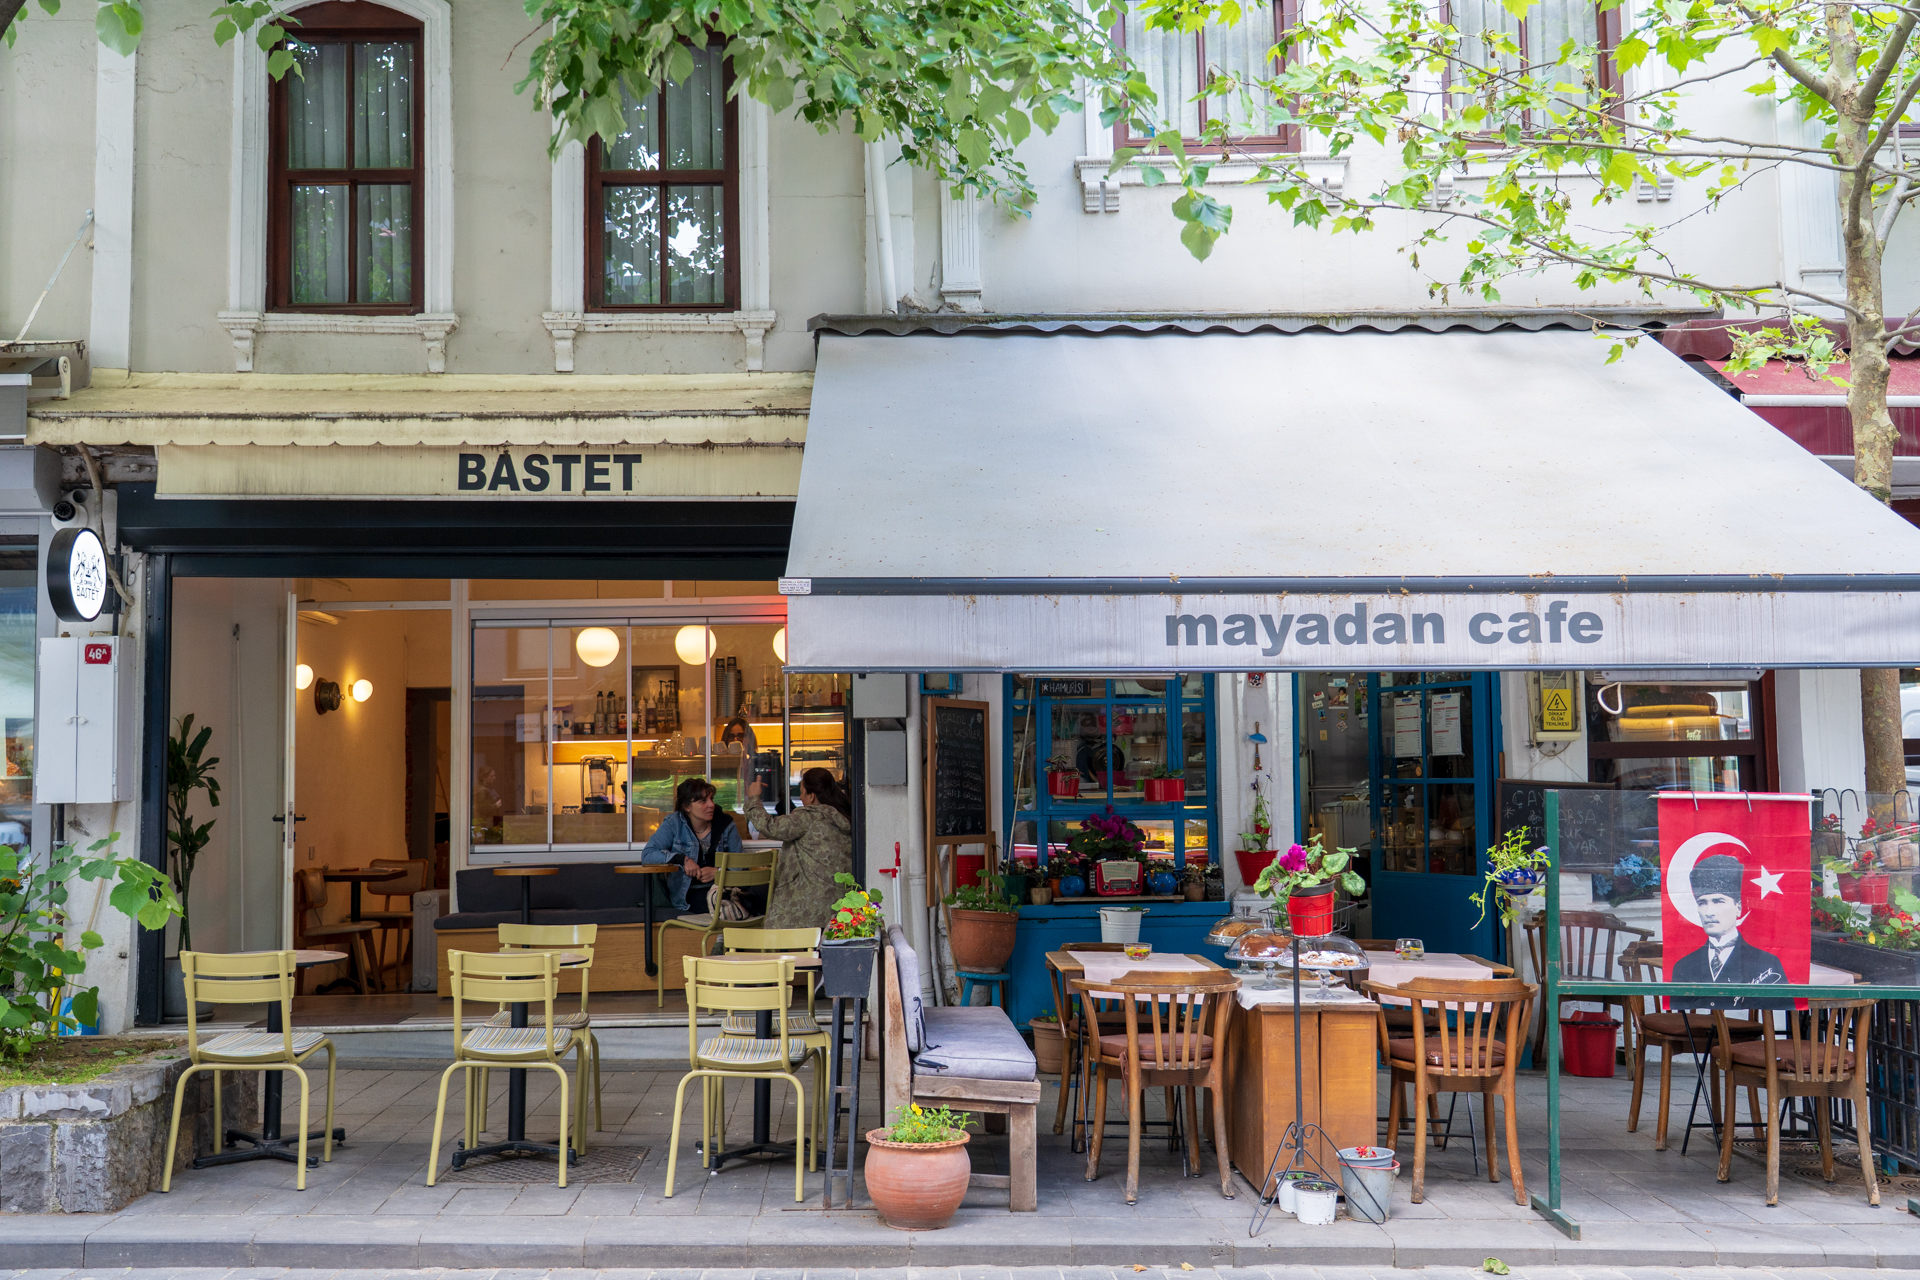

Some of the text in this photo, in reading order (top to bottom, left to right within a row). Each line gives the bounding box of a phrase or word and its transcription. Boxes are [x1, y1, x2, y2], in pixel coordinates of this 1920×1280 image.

[458, 453, 642, 492] BASTET
[76, 585, 99, 600] BASTET
[1165, 600, 1604, 657] mayadan cafe
